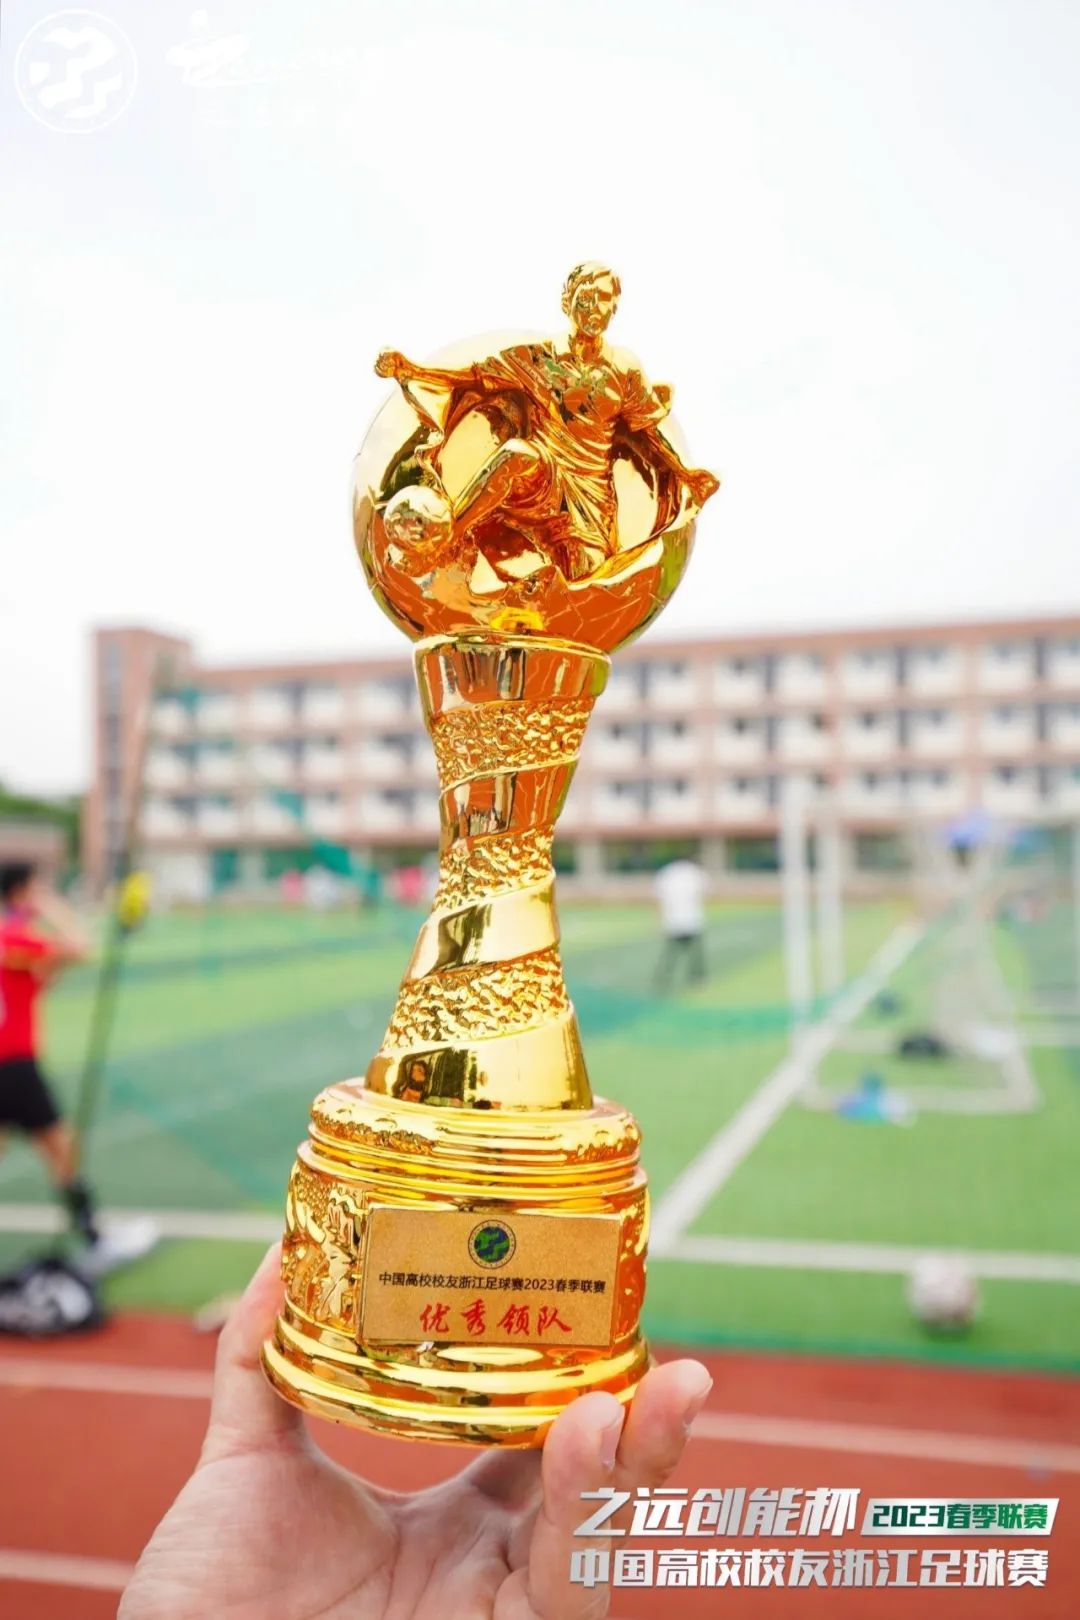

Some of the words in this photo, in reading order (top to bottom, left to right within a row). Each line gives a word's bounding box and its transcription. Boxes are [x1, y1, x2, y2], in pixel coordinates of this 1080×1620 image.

[378, 1272, 606, 1294] 中国高校校友浙江足球赛2023春季联赛
[420, 1299, 572, 1336] 优秀领队
